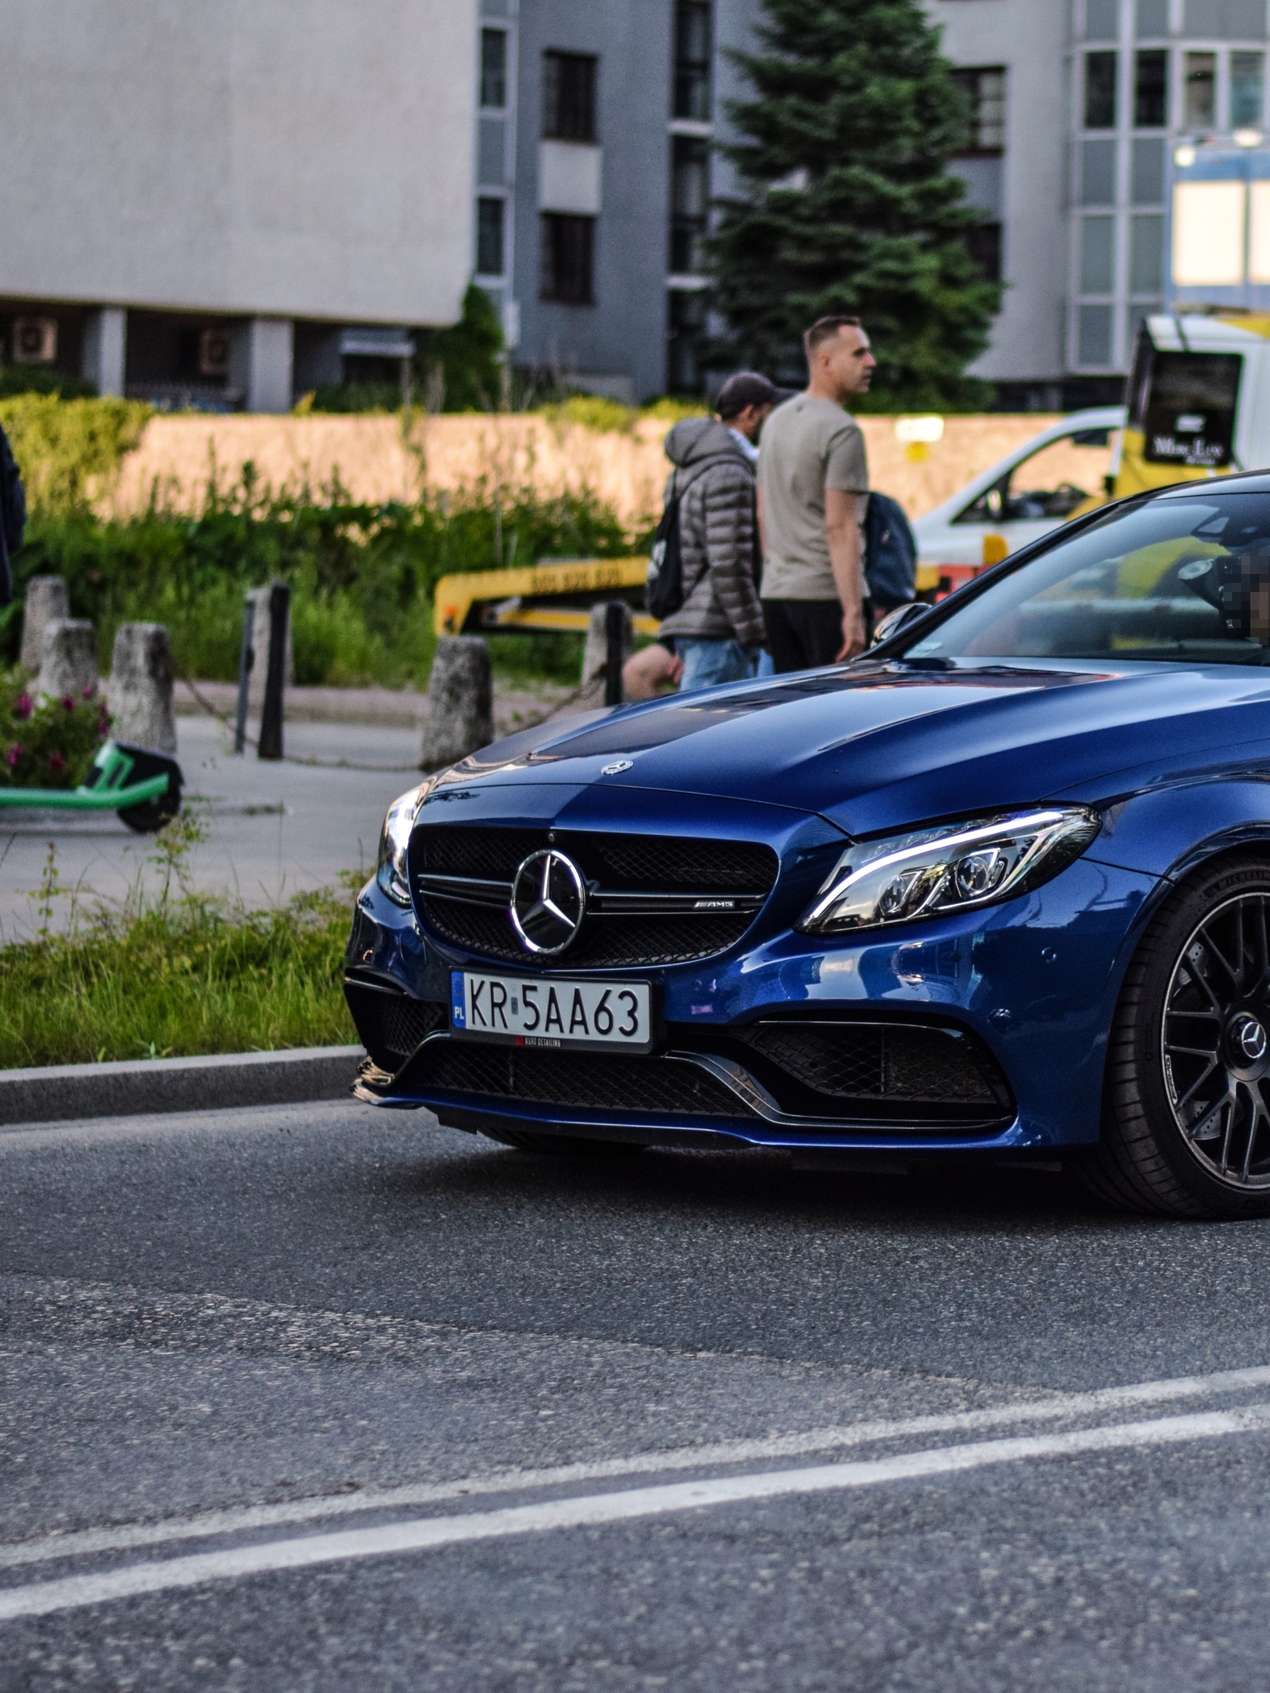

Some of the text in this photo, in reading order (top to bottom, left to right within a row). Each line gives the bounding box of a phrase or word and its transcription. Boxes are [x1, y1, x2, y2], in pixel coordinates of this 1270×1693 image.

[454, 1006, 465, 1020] PL
[470, 978, 639, 1037] KR 5AA63
